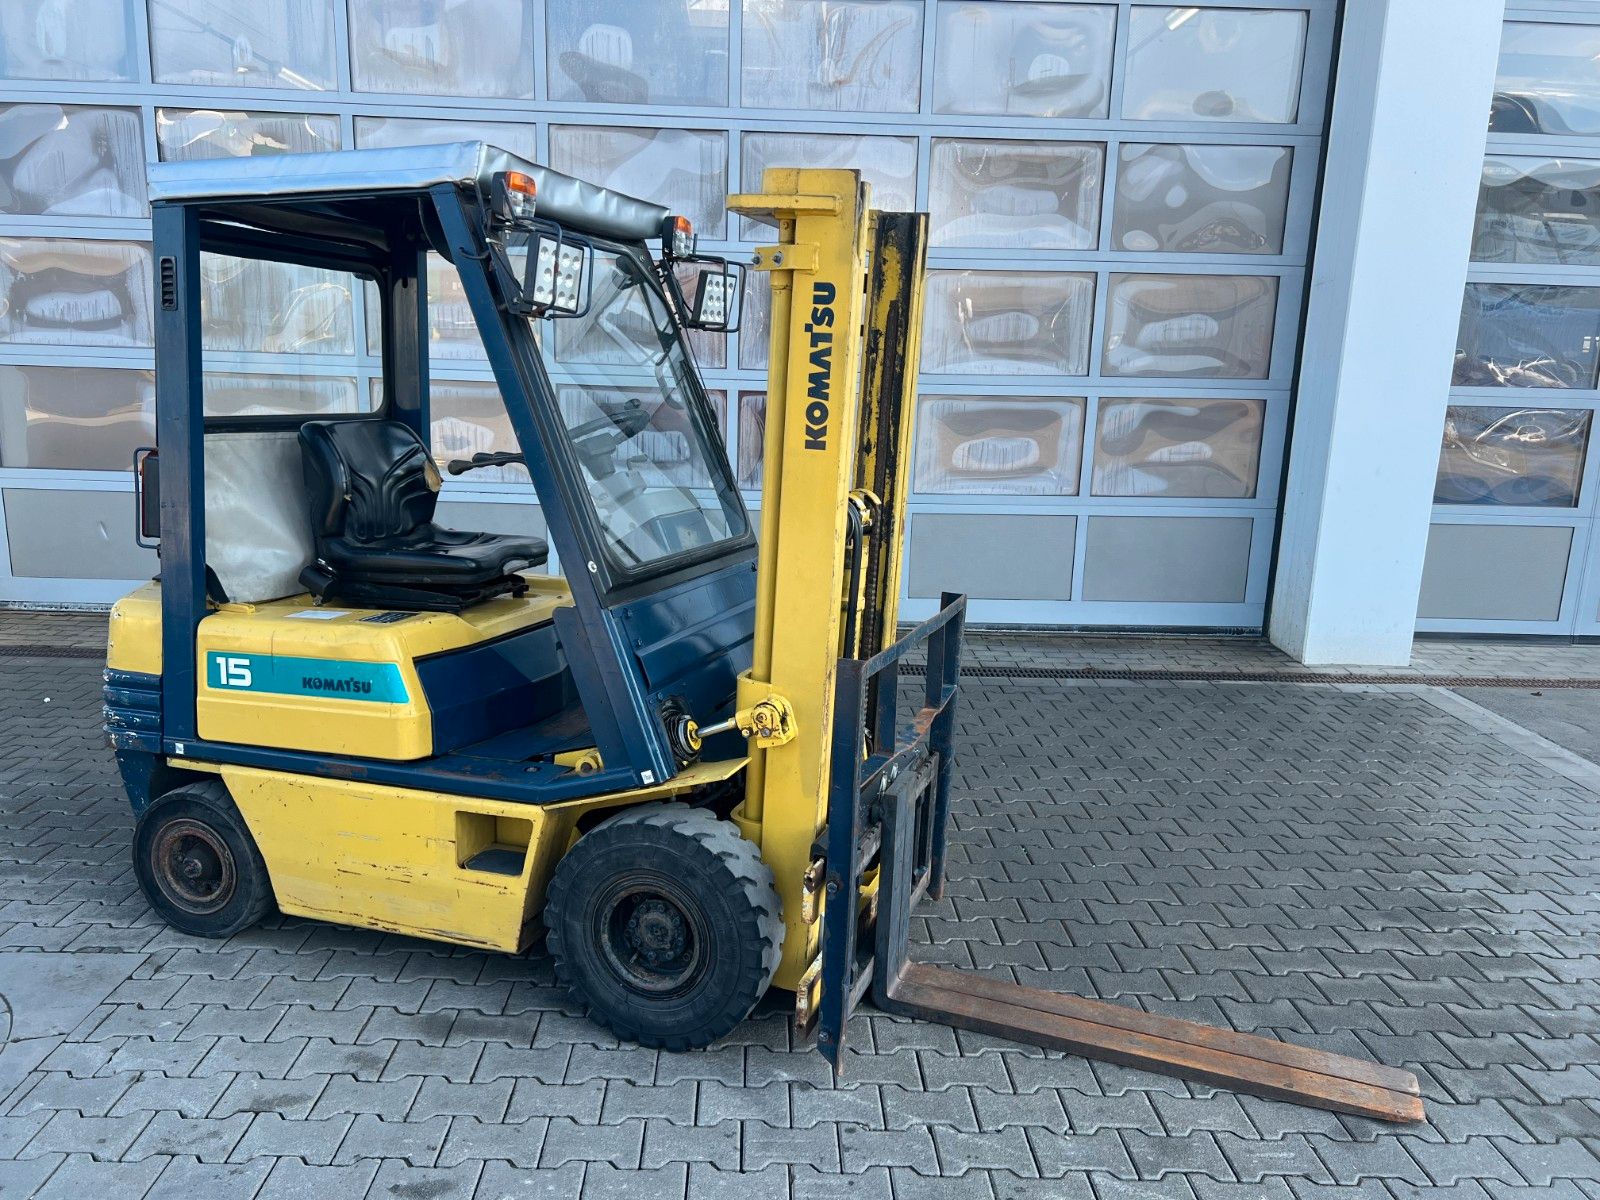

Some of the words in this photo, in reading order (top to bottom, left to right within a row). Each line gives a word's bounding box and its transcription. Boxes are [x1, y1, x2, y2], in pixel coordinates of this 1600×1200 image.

[804, 281, 836, 450] KOMATSU
[216, 656, 252, 687] 15
[302, 676, 372, 694] KOMATSU
